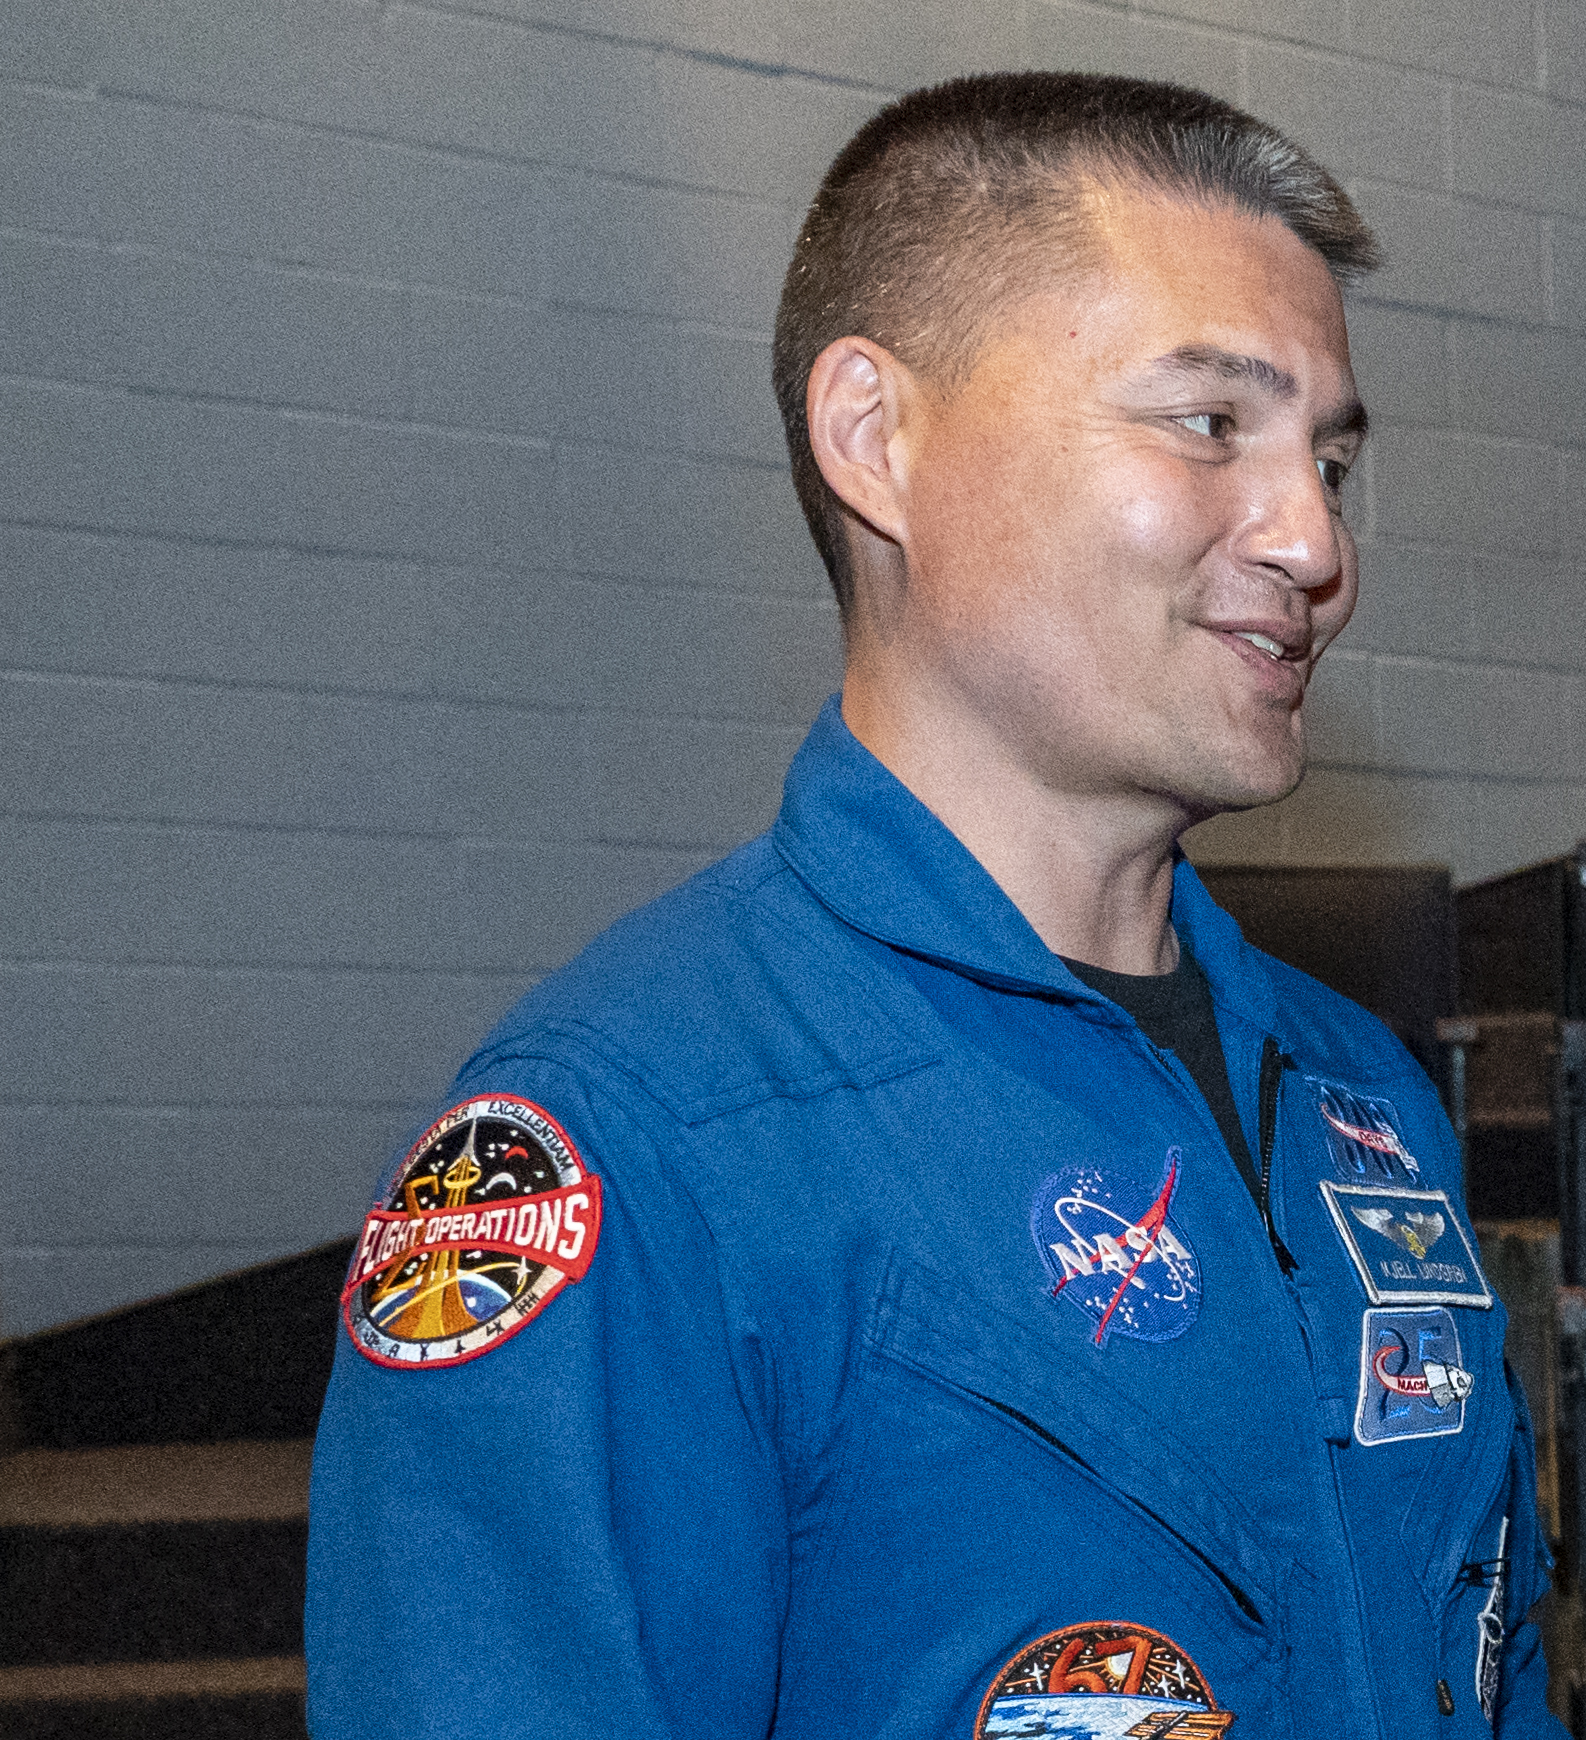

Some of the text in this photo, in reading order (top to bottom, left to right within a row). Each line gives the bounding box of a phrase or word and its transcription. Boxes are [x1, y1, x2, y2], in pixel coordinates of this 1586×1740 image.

[353, 1192, 589, 1282] FLIGHT OPERATIONS
[1051, 1225, 1193, 1282] NASA
[1049, 1635, 1151, 1694] 67
